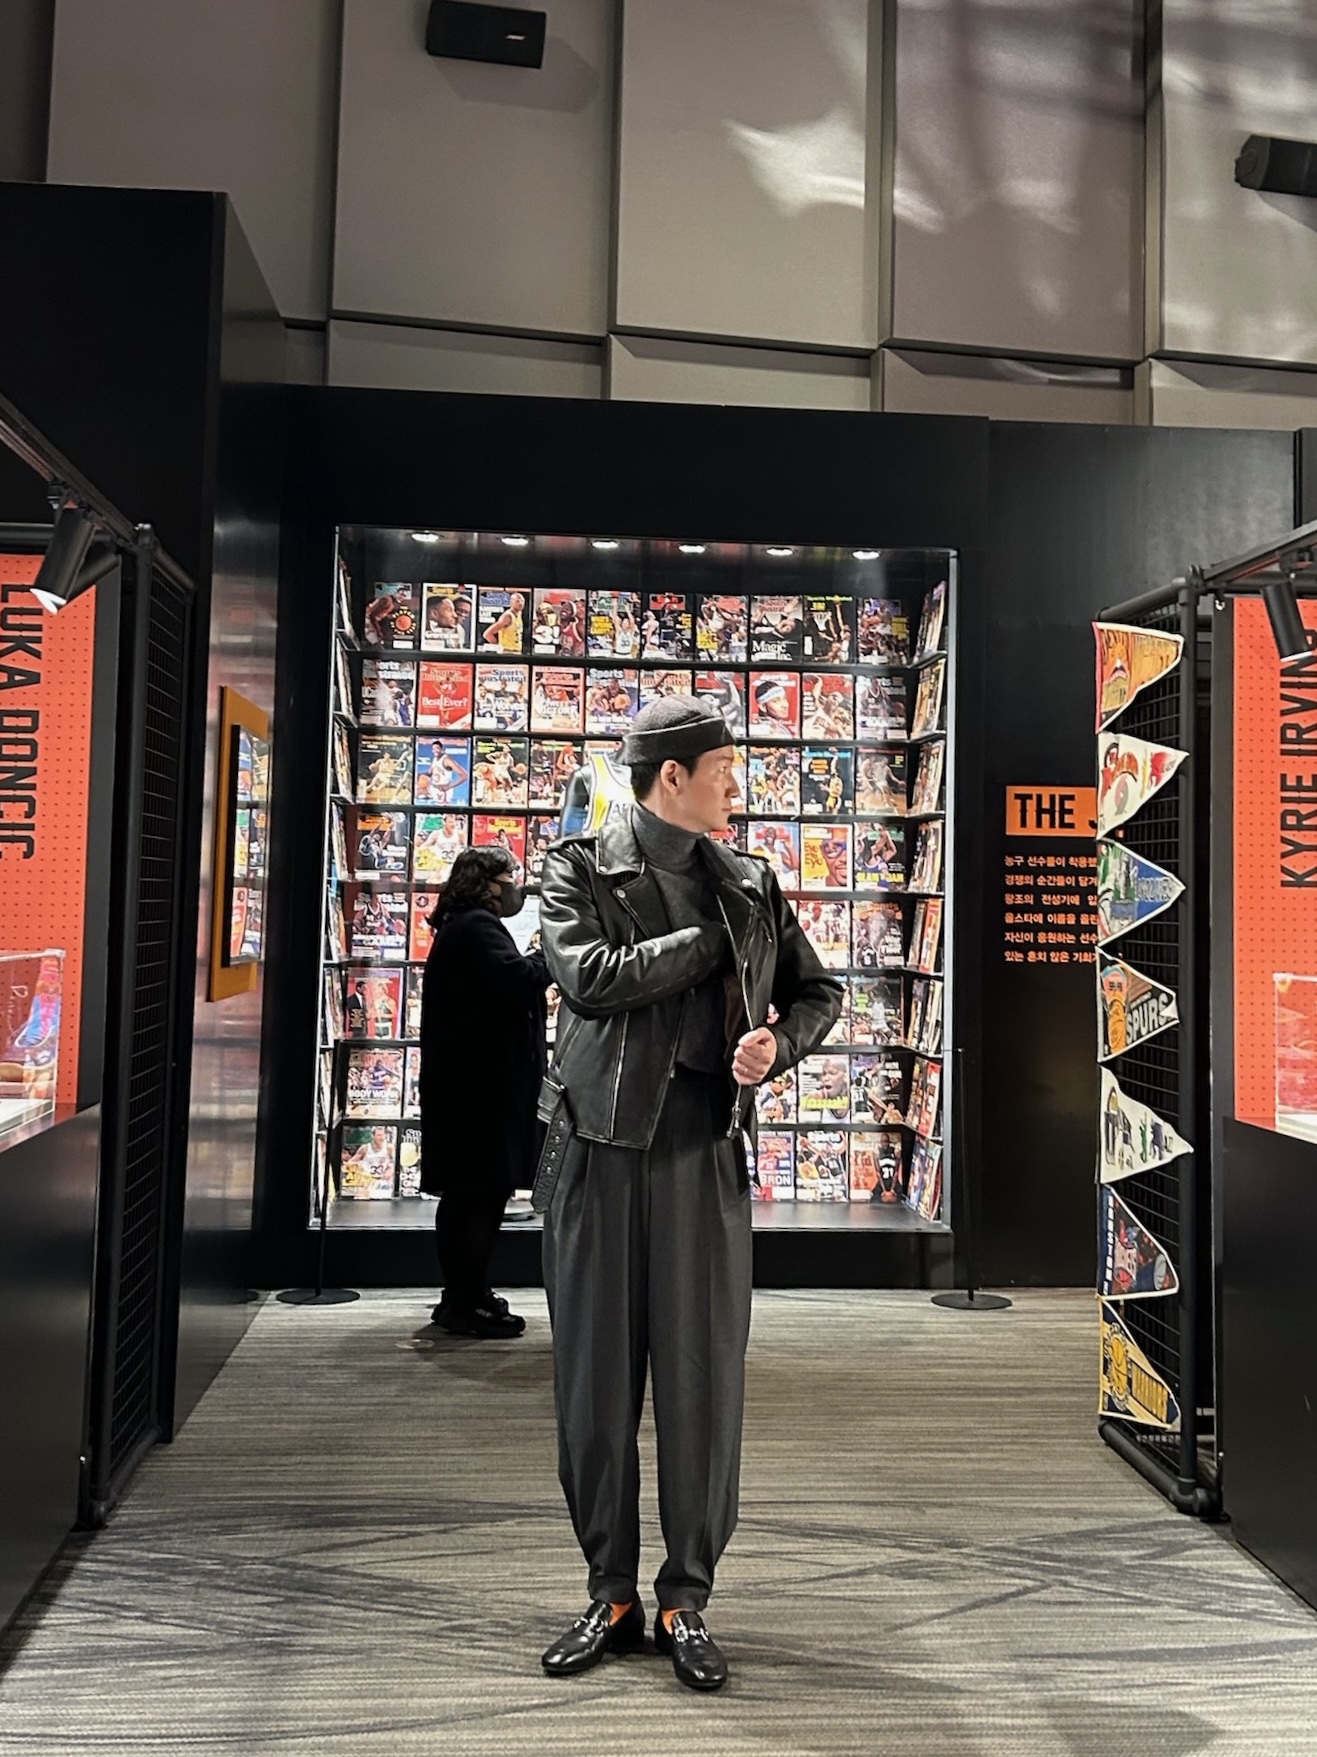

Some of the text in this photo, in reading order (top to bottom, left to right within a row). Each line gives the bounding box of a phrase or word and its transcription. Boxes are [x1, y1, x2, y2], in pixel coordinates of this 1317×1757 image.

[0, 584, 43, 690] LUKA
[752, 639, 787, 653] Magic
[493, 669, 524, 678] Sports
[590, 667, 624, 679] Sports
[422, 697, 468, 707] Best Ever?
[1014, 793, 1075, 829] THE
[1280, 773, 1317, 889] KYRIE
[1004, 855, 1025, 867] 농구
[1027, 855, 1066, 868] 선수들이
[1004, 874, 1034, 886] 경쟁의
[1036, 875, 1076, 887] 순간들이
[1004, 893, 1034, 905] 왕조의
[1041, 894, 1080, 906] 전성기에
[1004, 912, 1044, 924] 올스타에
[1047, 913, 1076, 925] 이름을
[1004, 931, 1034, 943] 자신이
[1037, 931, 1076, 944] 응원하는
[1004, 950, 1024, 962] 있는
[1049, 951, 1070, 963] 않은
[1126, 992, 1168, 1045] SPURS
